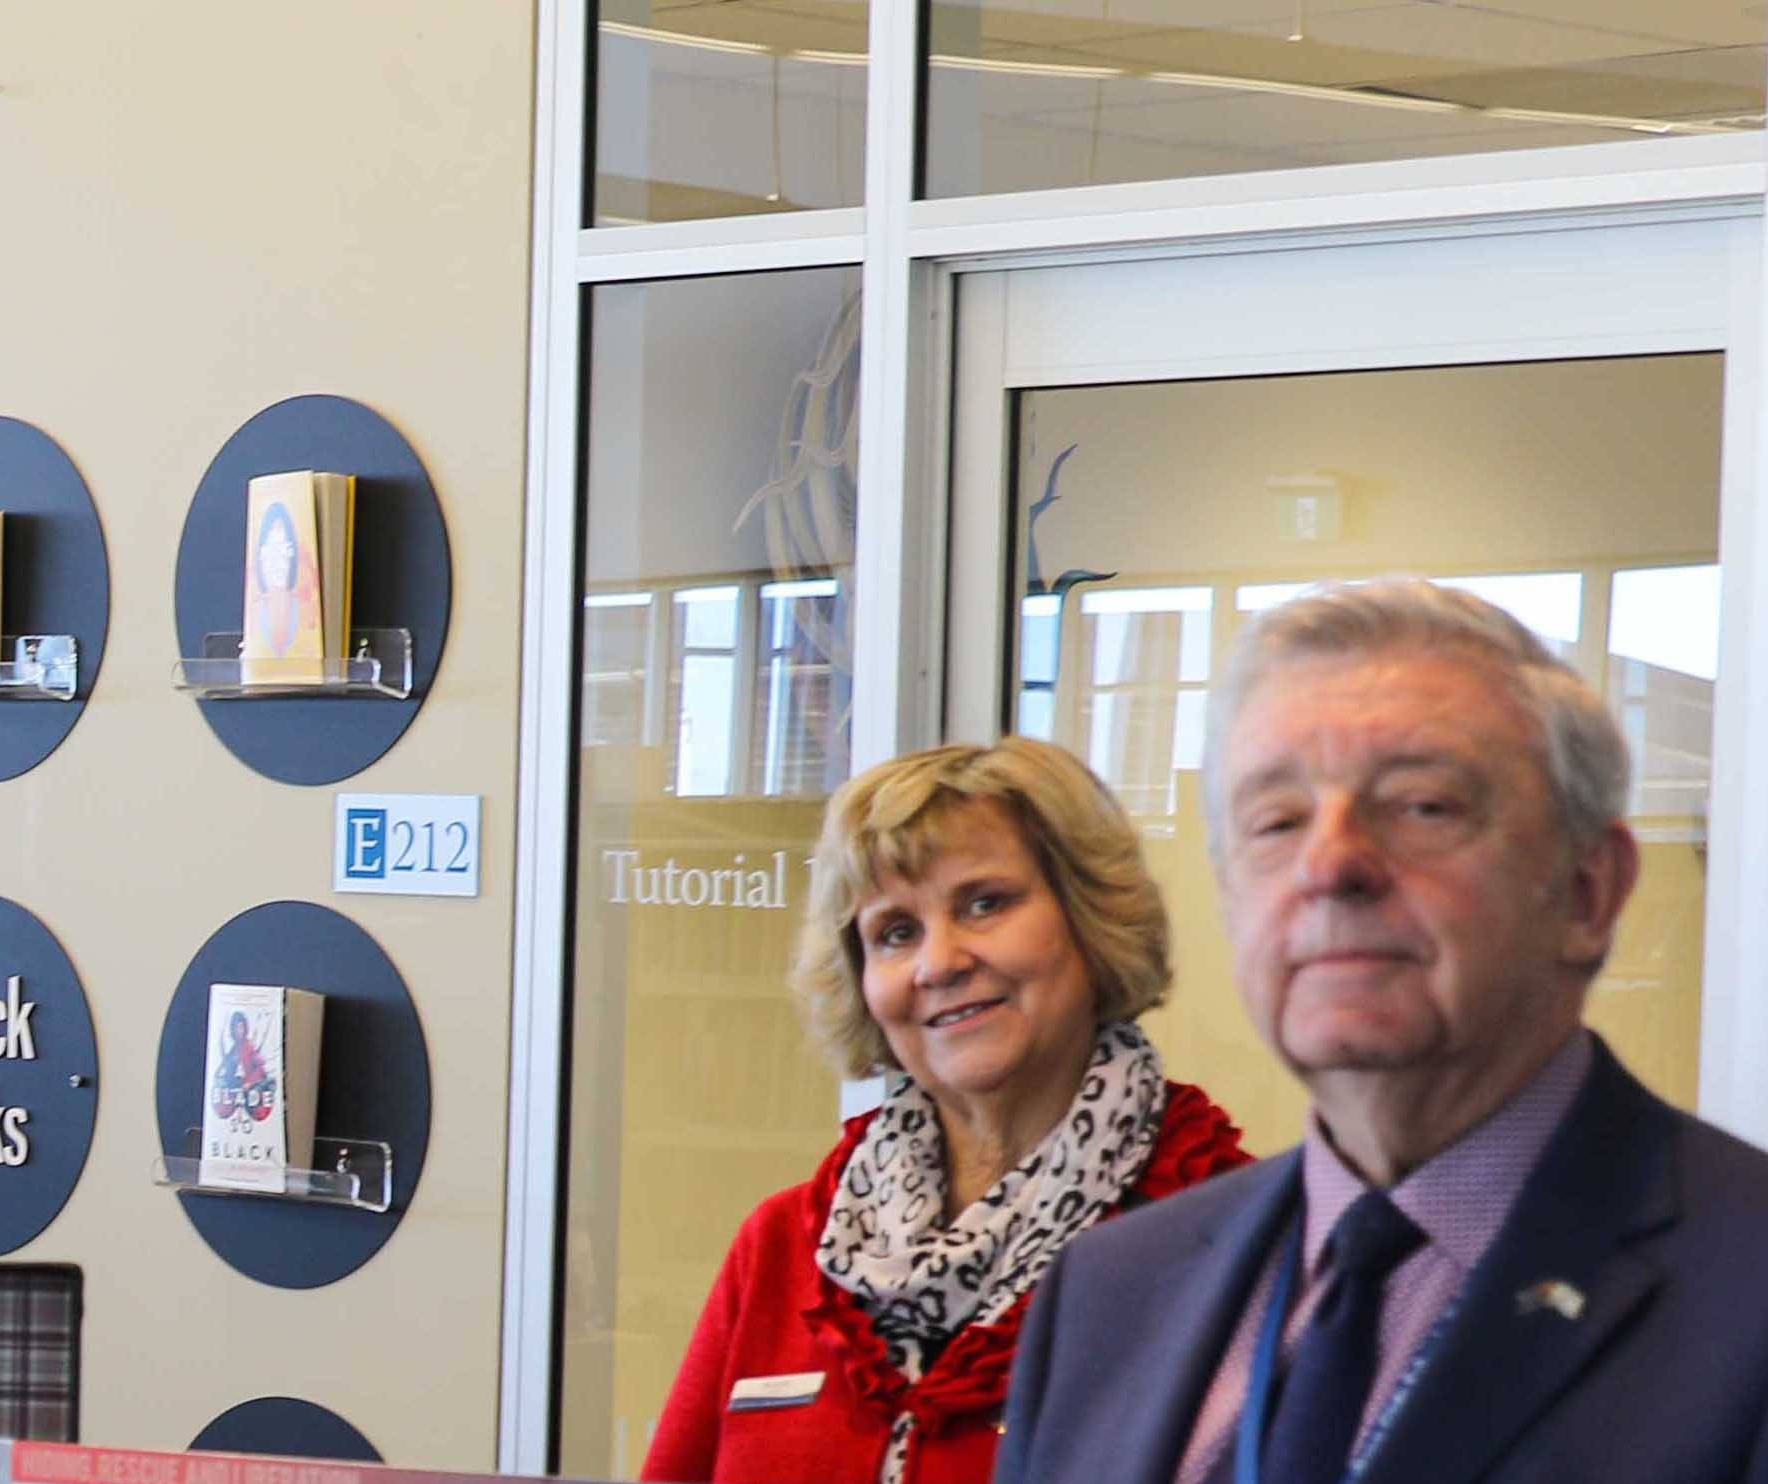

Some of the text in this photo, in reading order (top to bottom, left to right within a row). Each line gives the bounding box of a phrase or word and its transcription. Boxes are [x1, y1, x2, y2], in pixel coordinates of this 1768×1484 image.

[602, 850, 787, 908] Tutorial
[212, 1087, 274, 1107] BLADE
[209, 1141, 275, 1161] BLACK
